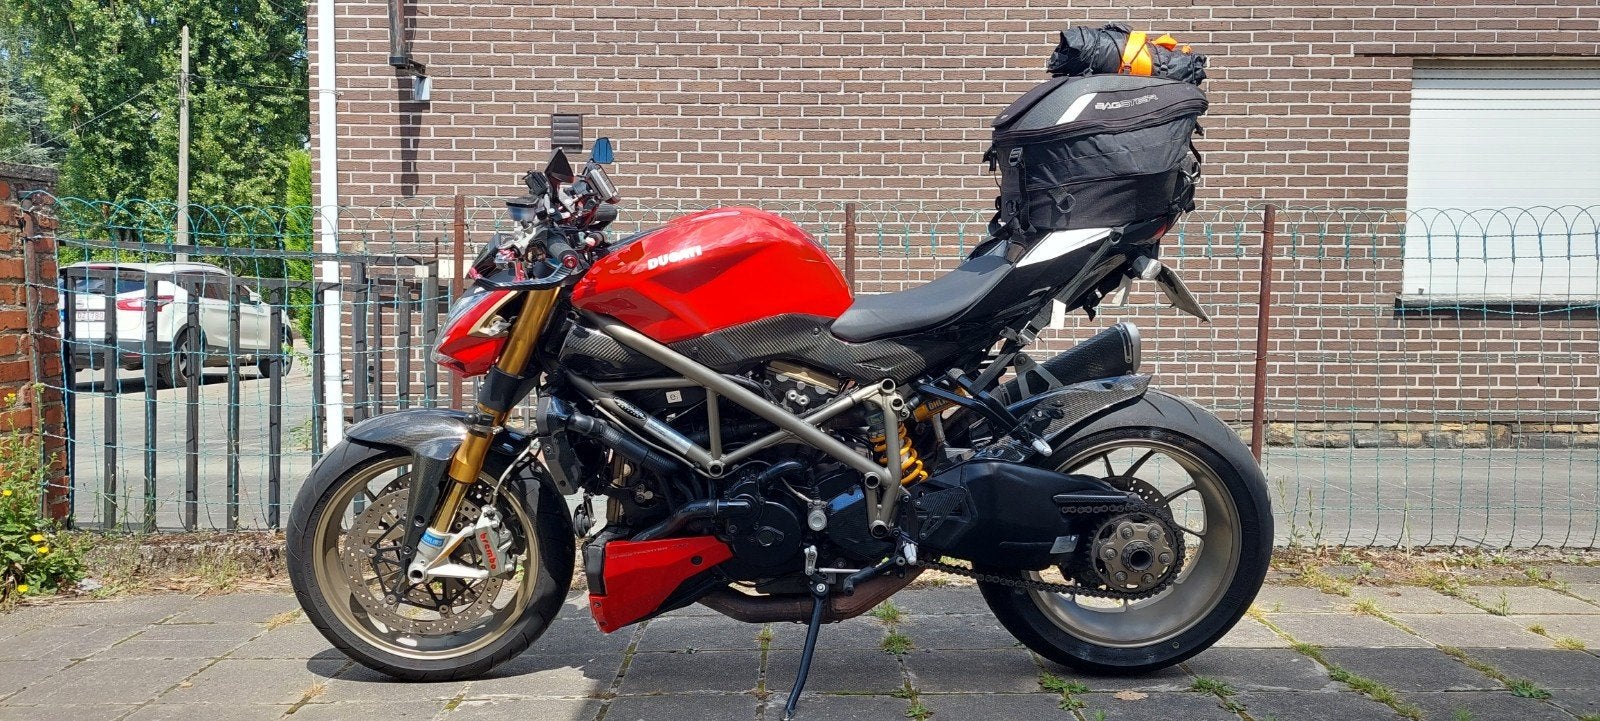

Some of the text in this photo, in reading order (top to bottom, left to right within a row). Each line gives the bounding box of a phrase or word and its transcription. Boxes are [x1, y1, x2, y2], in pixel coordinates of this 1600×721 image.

[1095, 94, 1158, 110] BAGSTER
[647, 244, 702, 270] DUCATI
[480, 532, 496, 569] brembo
